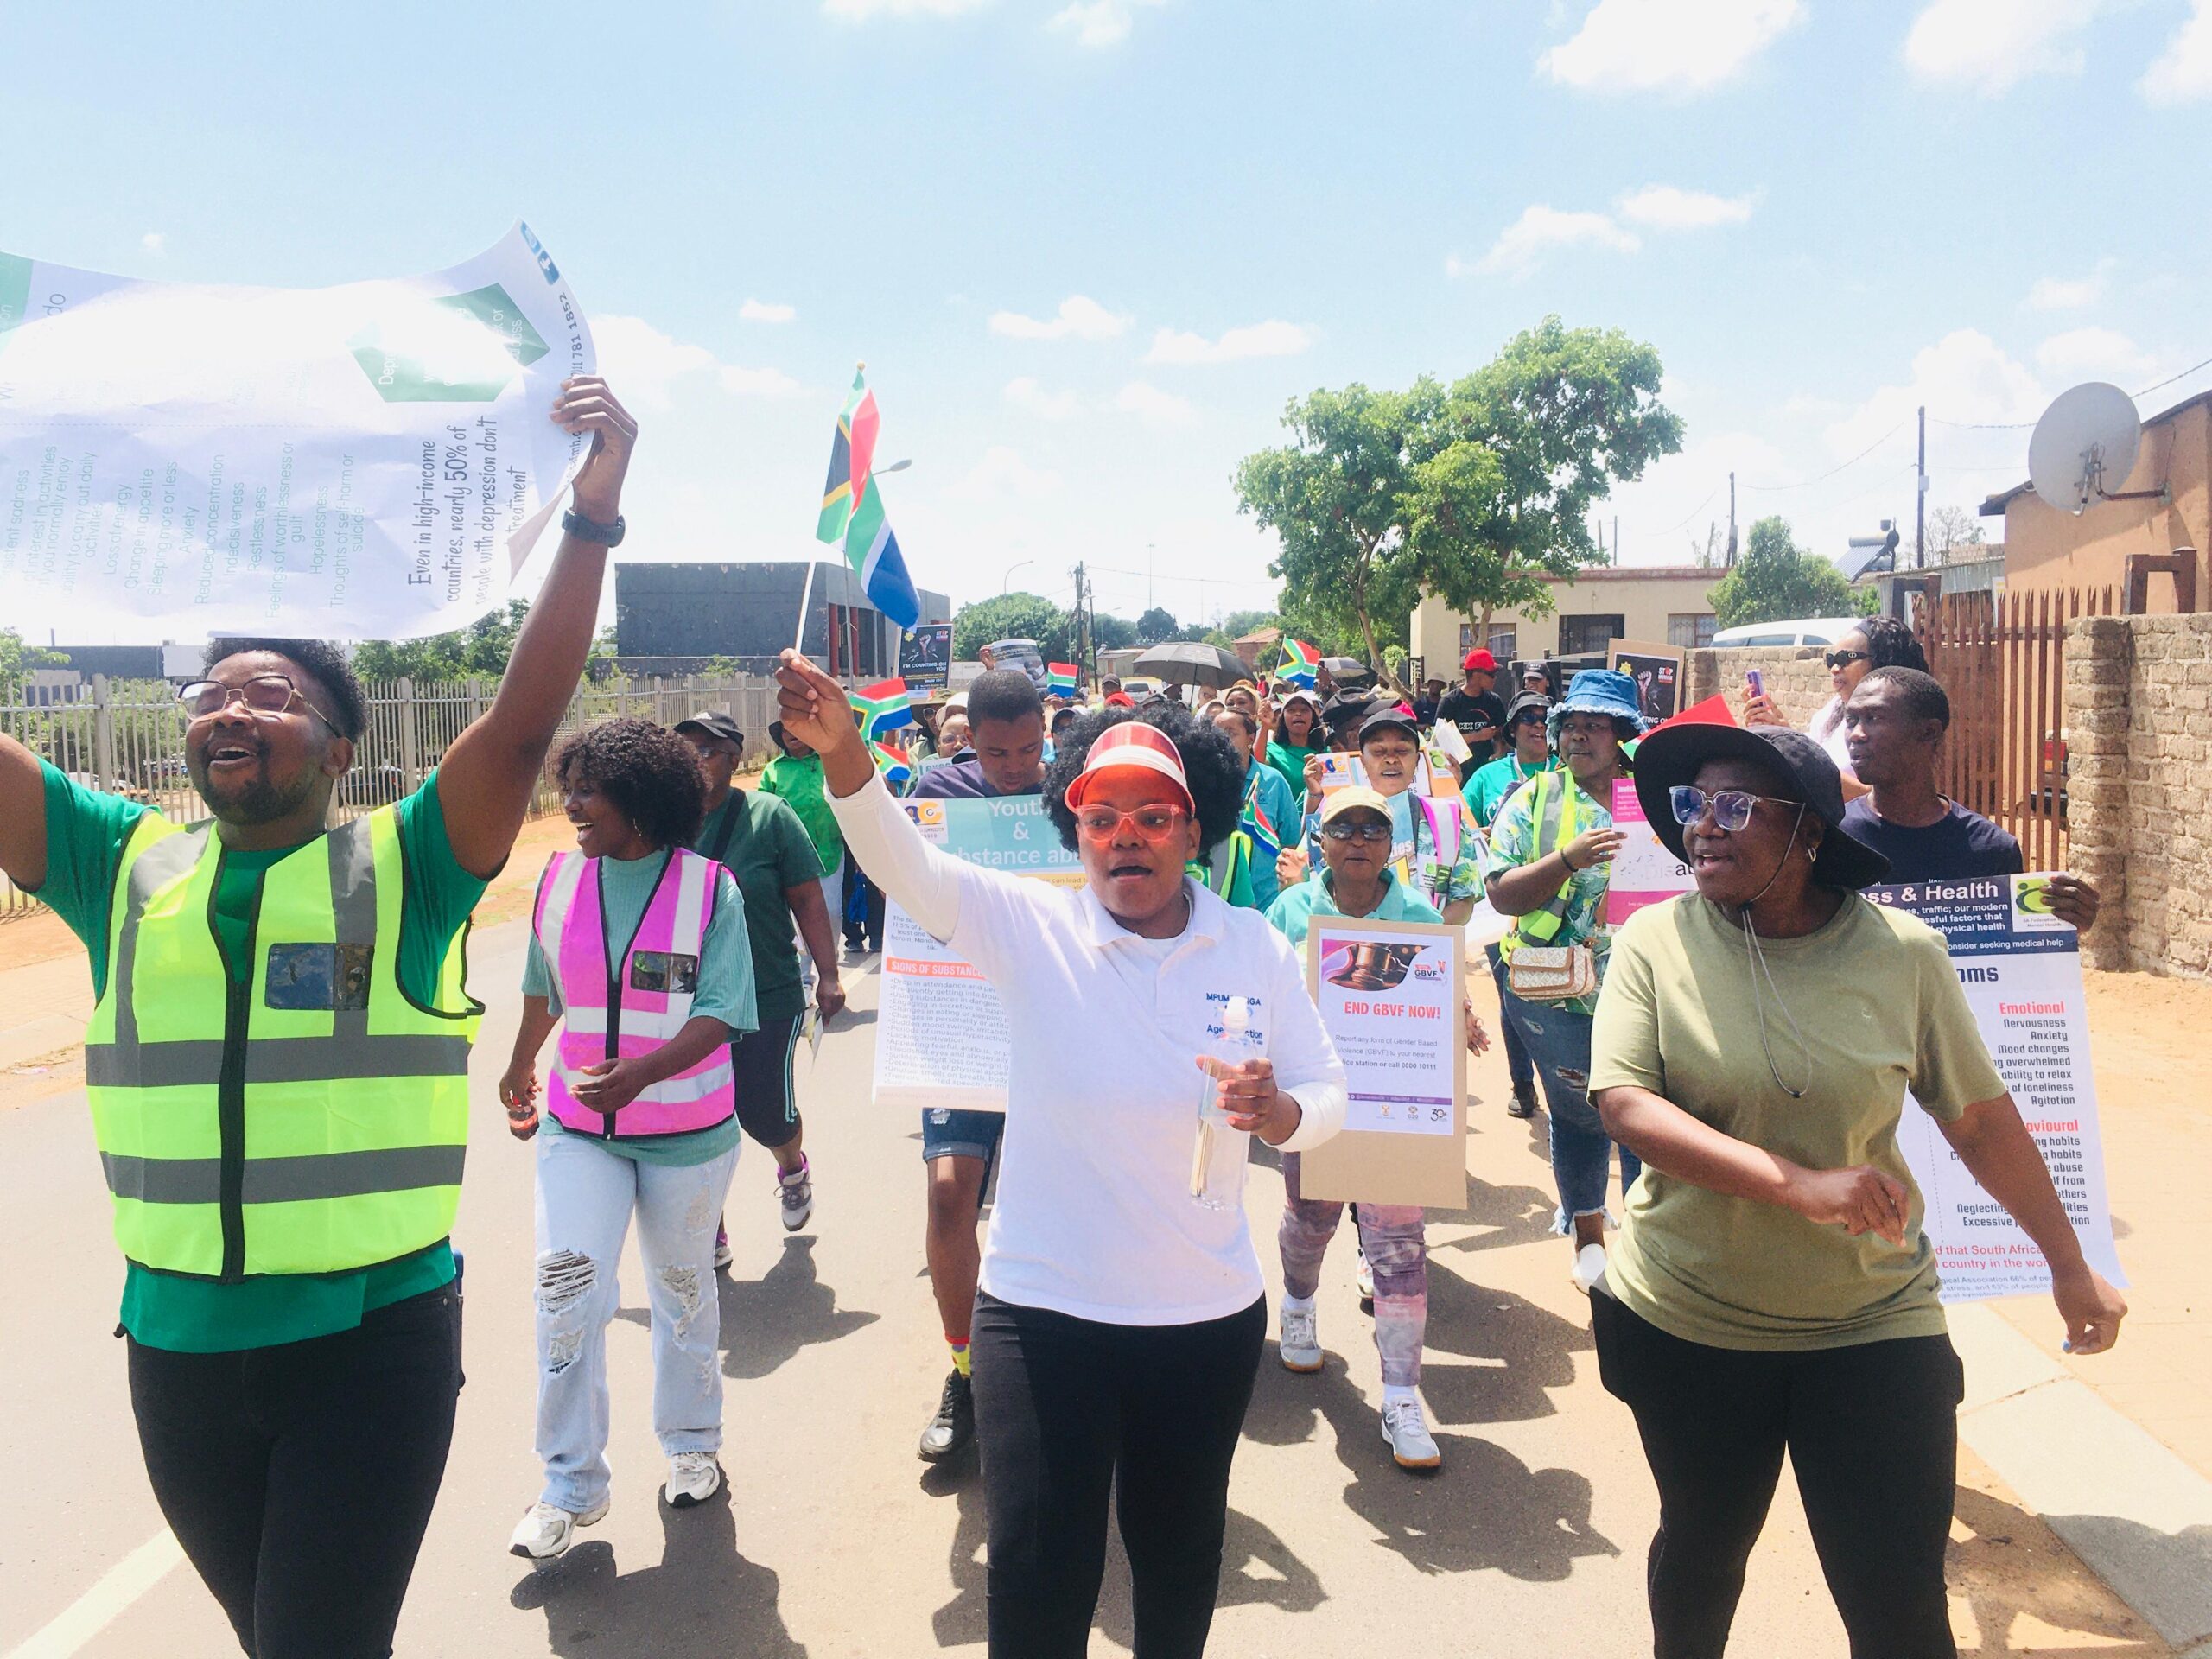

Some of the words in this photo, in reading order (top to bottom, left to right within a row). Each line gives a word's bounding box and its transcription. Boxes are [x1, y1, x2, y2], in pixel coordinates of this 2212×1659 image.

[559, 292, 577, 329] 1852
[570, 334, 582, 358] 781
[447, 425, 467, 440] of
[476, 416, 497, 452] don't
[282, 442, 293, 454] or
[78, 452, 97, 482] daily
[341, 454, 353, 467] or
[445, 445, 467, 481] 50%
[38, 446, 57, 502] activities
[56, 457, 73, 491] enjoy
[162, 461, 177, 486] less
[412, 441, 440, 527] high-income
[474, 457, 502, 531] depression
[10, 470, 29, 524] sadness
[77, 486, 90, 505] out
[163, 491, 175, 503] or
[273, 457, 292, 546] worthlessness
[335, 469, 353, 528] self-harm
[505, 465, 526, 532] treatment
[35, 505, 48, 516] in
[111, 484, 132, 528] energy
[444, 487, 472, 530] nearly
[46, 496, 68, 549] normally
[72, 510, 87, 541] carry
[85, 504, 104, 557] activities
[124, 539, 147, 588] Change
[137, 469, 154, 523] appetite
[160, 507, 173, 538] more
[178, 506, 198, 553] Anxiety
[194, 548, 215, 604] Reduced
[205, 454, 225, 543] concentration
[223, 482, 244, 576] Indecisiveness
[247, 486, 267, 572] Restlessness
[289, 515, 305, 543] guilt
[310, 486, 328, 575] Hopelessness
[351, 506, 365, 552] suicide
[27, 521, 45, 566] interest
[109, 531, 122, 543] of
[335, 531, 348, 543] of
[414, 532, 432, 544] in
[271, 550, 285, 563] of
[474, 536, 494, 563] with
[102, 546, 119, 575] Loss
[147, 543, 172, 595] Sleeping
[408, 550, 432, 585] Even
[442, 536, 465, 601] countries,
[330, 547, 350, 607] Thoughts
[472, 568, 496, 605] people
[264, 567, 288, 619] Feelings
[1014, 821, 1030, 840] &
[957, 847, 1039, 865] bstance
[1901, 887, 1917, 902] &
[1925, 881, 1999, 901] Health
[1922, 905, 1951, 915] traffic;
[1955, 904, 1970, 912] our
[1973, 902, 2008, 912] modern
[1949, 913, 1982, 923] factors
[1984, 912, 2003, 921] that
[1947, 941, 1977, 950] onsider
[1980, 940, 2011, 949] seeking
[2012, 939, 2044, 948] medical
[2046, 938, 2064, 949] help
[891, 961, 918, 973] SIGNS
[893, 984, 933, 995] Frequently
[936, 988, 963, 997] getting
[894, 977, 912, 986] Drop
[923, 981, 966, 989] attendance
[892, 998, 928, 1008] Engaging
[893, 992, 913, 1001] Using
[893, 1005, 925, 1014] Changes
[972, 1012, 1003, 1023] sleeping
[1344, 1002, 1369, 1014] END
[1373, 1003, 1404, 1017] GBVF
[1408, 1006, 1440, 1019] NOW!
[1999, 1001, 2065, 1014] Emotional
[892, 1012, 925, 1021] Changes
[935, 1016, 976, 1027] personality
[2004, 1019, 2066, 1027] Nervousness
[2031, 1031, 2068, 1042] Anxiety
[1998, 1045, 2025, 1054] Mood
[2028, 1045, 2069, 1054] changes
[2006, 1056, 2070, 1066] overwhelmed
[2036, 1070, 2044, 1078] to
[2012, 1084, 2020, 1092] of
[2024, 1083, 2074, 1092] loneliness
[2031, 1096, 2075, 1107] Agitation
[2050, 1137, 2081, 1147] habits
[2051, 1150, 2082, 1160] habits
[2054, 1163, 2083, 1173] abuse
[2063, 1176, 2085, 1185] from
[1963, 1217, 2012, 1227] Excessive
[1946, 1246, 1968, 1255] that
[1972, 1245, 2005, 1255] South
[1942, 1260, 1986, 1270] country
[1990, 1258, 2001, 1268] in
[2004, 1258, 2023, 1268] the
